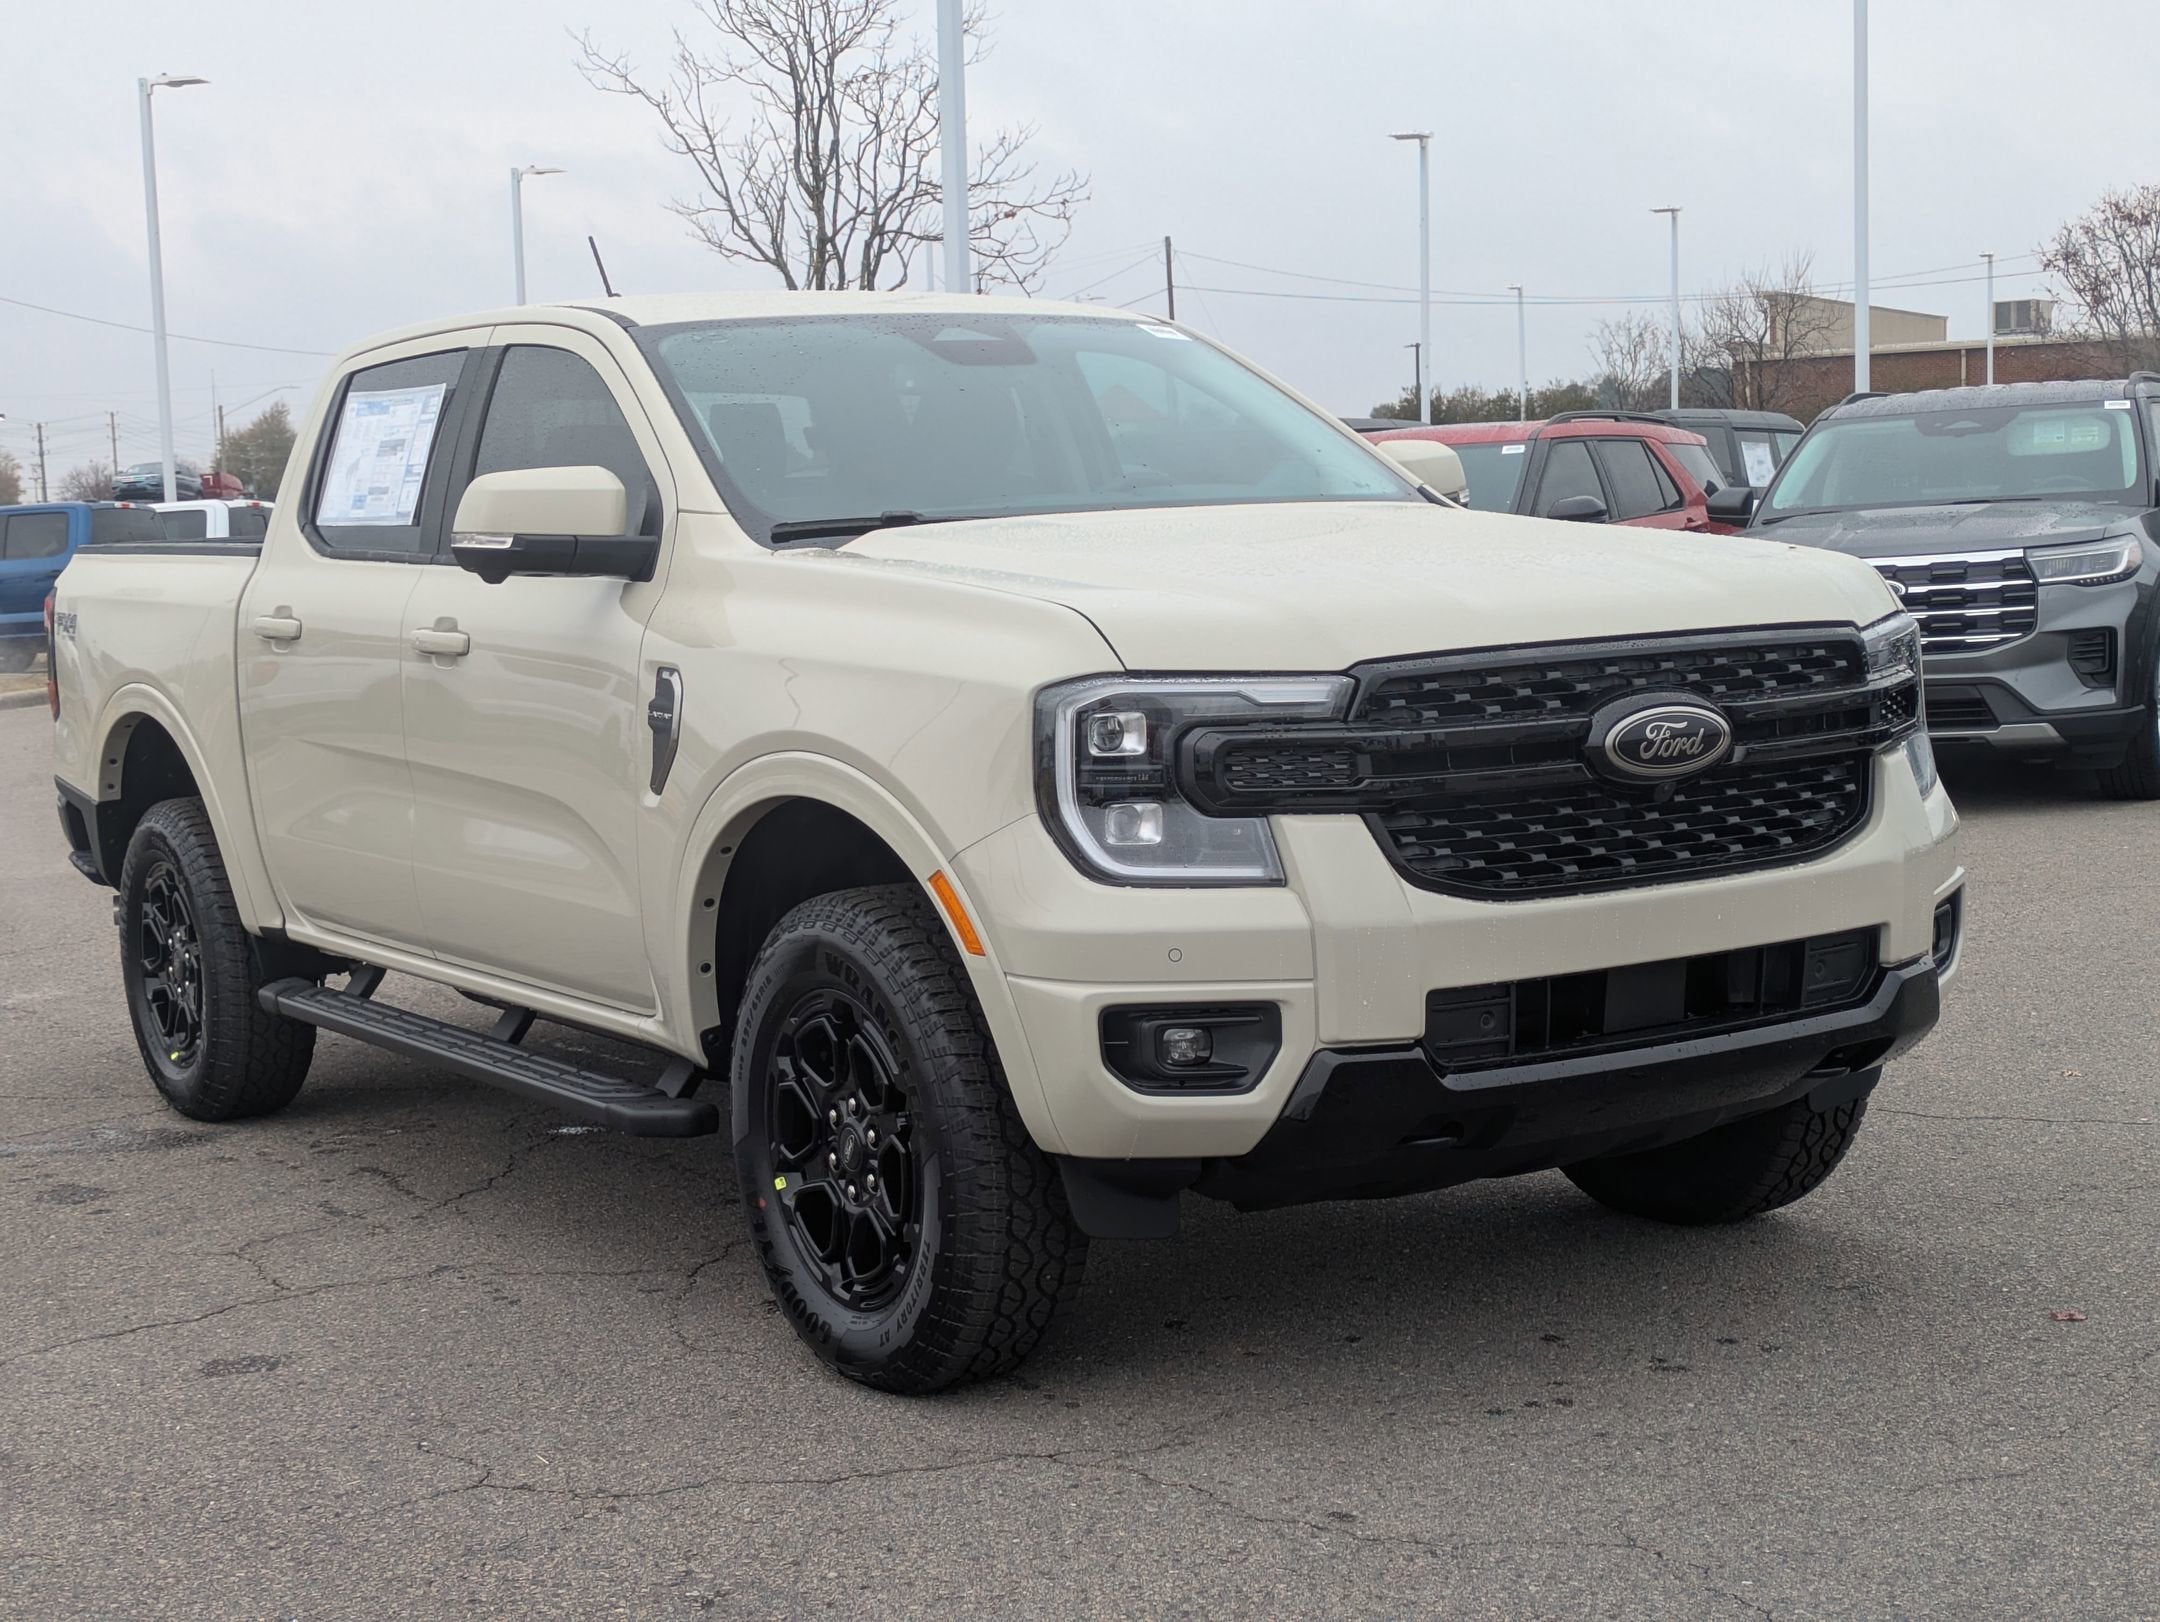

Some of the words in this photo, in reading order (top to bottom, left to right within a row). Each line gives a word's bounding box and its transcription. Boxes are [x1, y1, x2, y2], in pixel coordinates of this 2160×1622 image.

[1639, 721, 1705, 760] Ford
[896, 1240, 931, 1333] TERRITORY
[879, 1328, 891, 1348] AT
